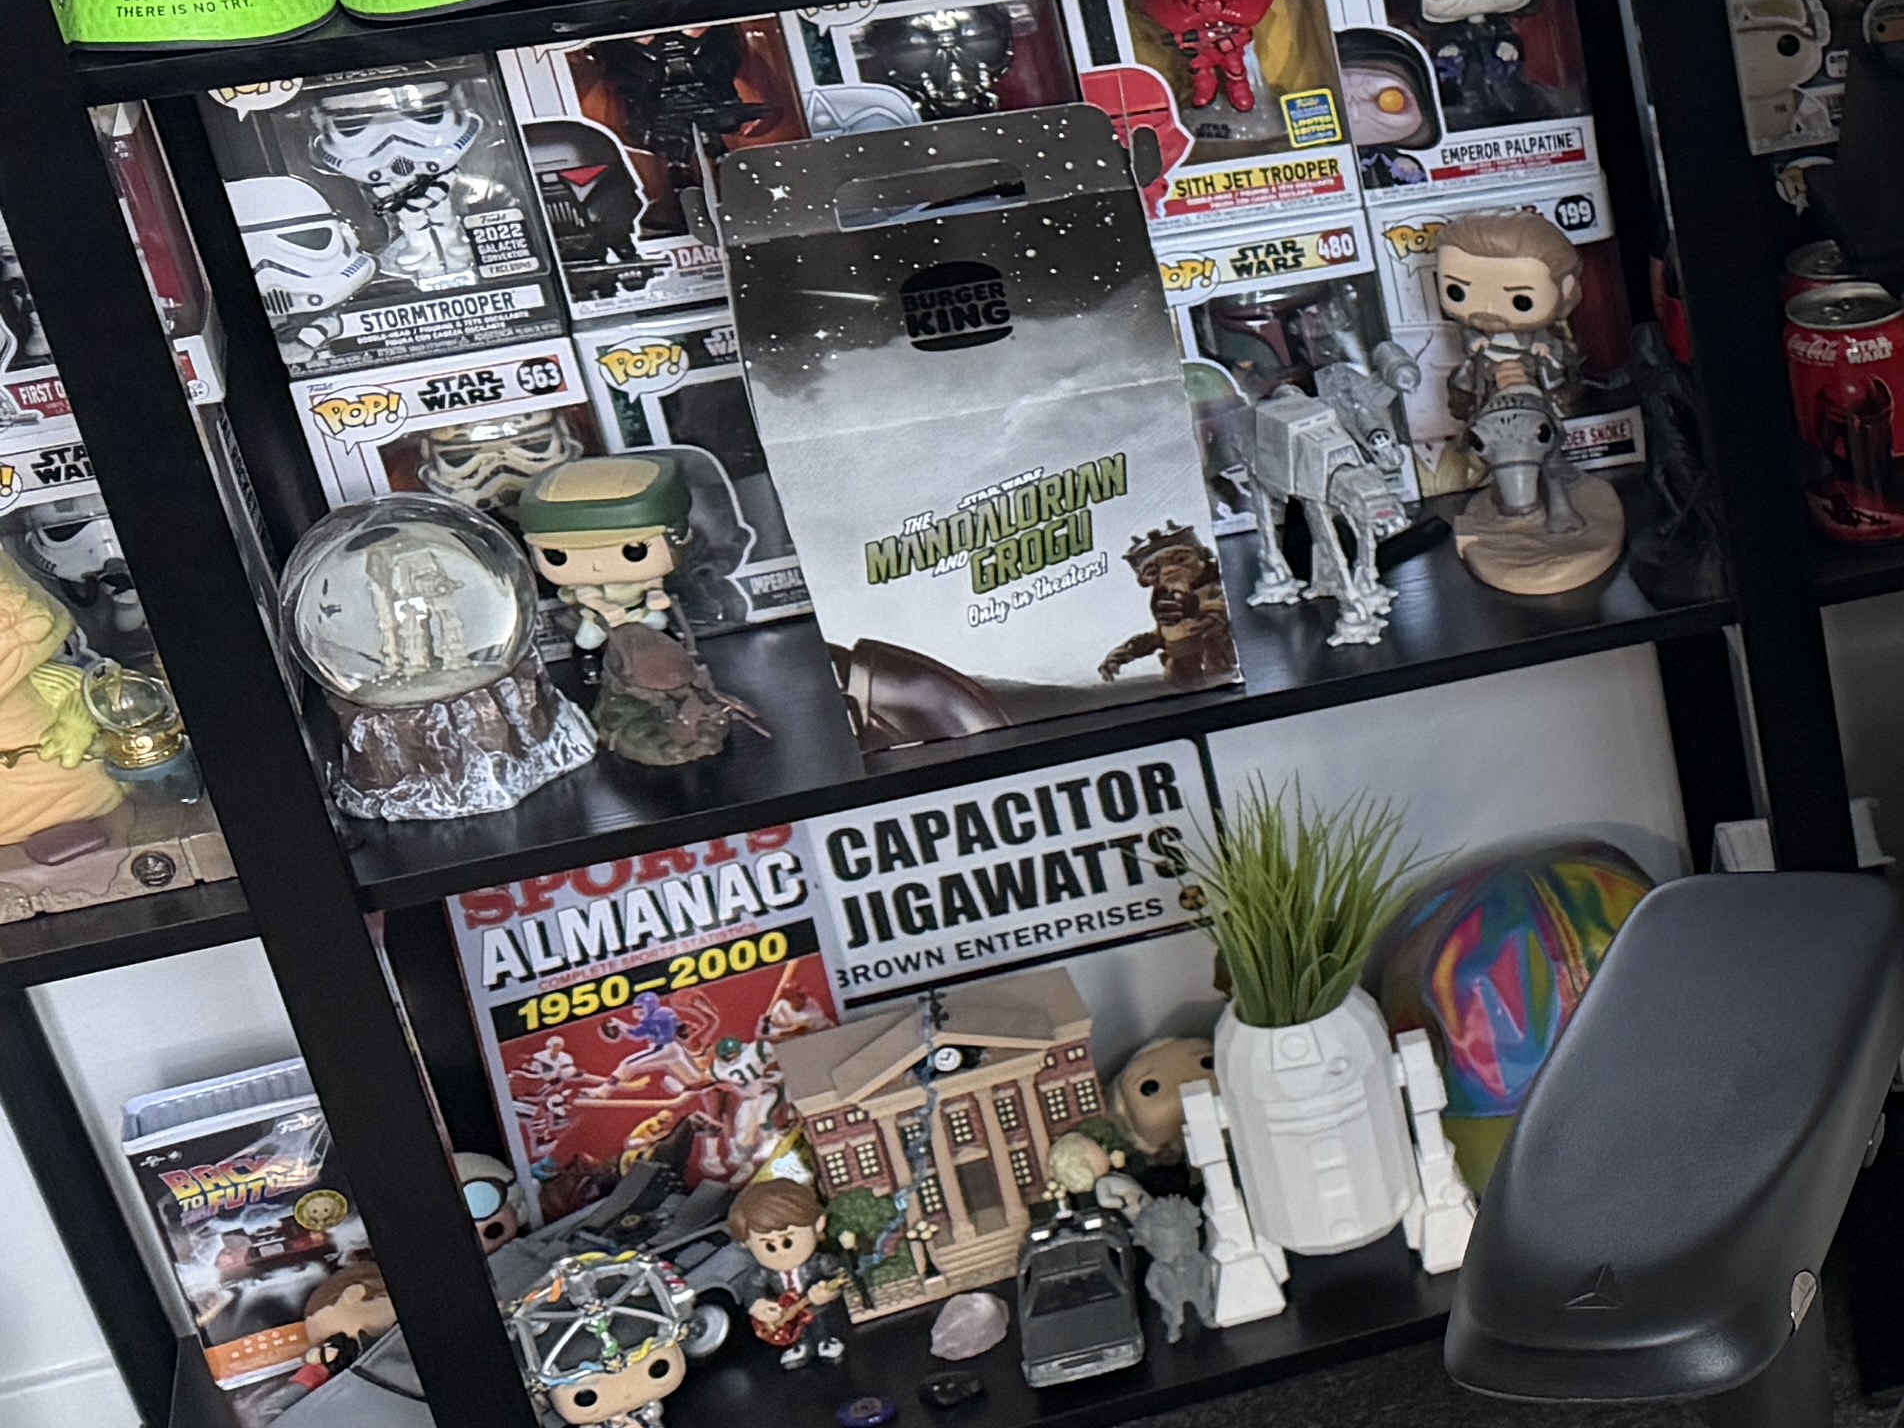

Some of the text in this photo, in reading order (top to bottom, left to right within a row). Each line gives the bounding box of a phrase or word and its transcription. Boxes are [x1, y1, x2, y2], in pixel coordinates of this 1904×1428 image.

[116, 5, 166, 18] THERE
[172, 3, 188, 15] IS
[194, 1, 217, 14] NO
[1441, 141, 1501, 165] EMPEROR
[1505, 132, 1574, 156] PALPATINE
[1174, 176, 1215, 198] SITH
[1221, 171, 1259, 191] JET
[1262, 158, 1340, 187] TROOPER
[1557, 199, 1592, 224] 199
[472, 223, 524, 243] 2022
[477, 237, 528, 254] GALACTIC
[1317, 231, 1354, 258] 480
[1229, 239, 1306, 264] STAR
[1231, 256, 1304, 278] WARS
[900, 280, 1007, 313] BURGER
[361, 292, 517, 333] STORMTROOPER
[904, 300, 1011, 338] KING
[519, 361, 562, 391] 563
[599, 345, 682, 386] POP!
[19, 384, 55, 406] FIRST
[419, 369, 504, 396] STAR
[313, 392, 402, 434] POP!
[421, 387, 505, 412] WARS
[30, 444, 87, 469] STA
[33, 462, 97, 484] WA
[958, 468, 1045, 510] STAR WARS
[865, 452, 1128, 586] MANDALORIAN
[902, 512, 933, 536] THE
[932, 508, 1094, 595] AND GROGU
[967, 553, 1109, 628] Only in theaters!
[825, 760, 1185, 883] CAPACITOR
[843, 825, 1187, 950] JIGAWATTS
[481, 850, 807, 992] ALMANAC
[537, 961, 625, 992] COMPLETE
[686, 924, 760, 956] STATISTICS
[834, 895, 1165, 992] BROWN ENTERPRISES
[728, 1064, 760, 1085] 31
[178, 1196, 205, 1213] TO
